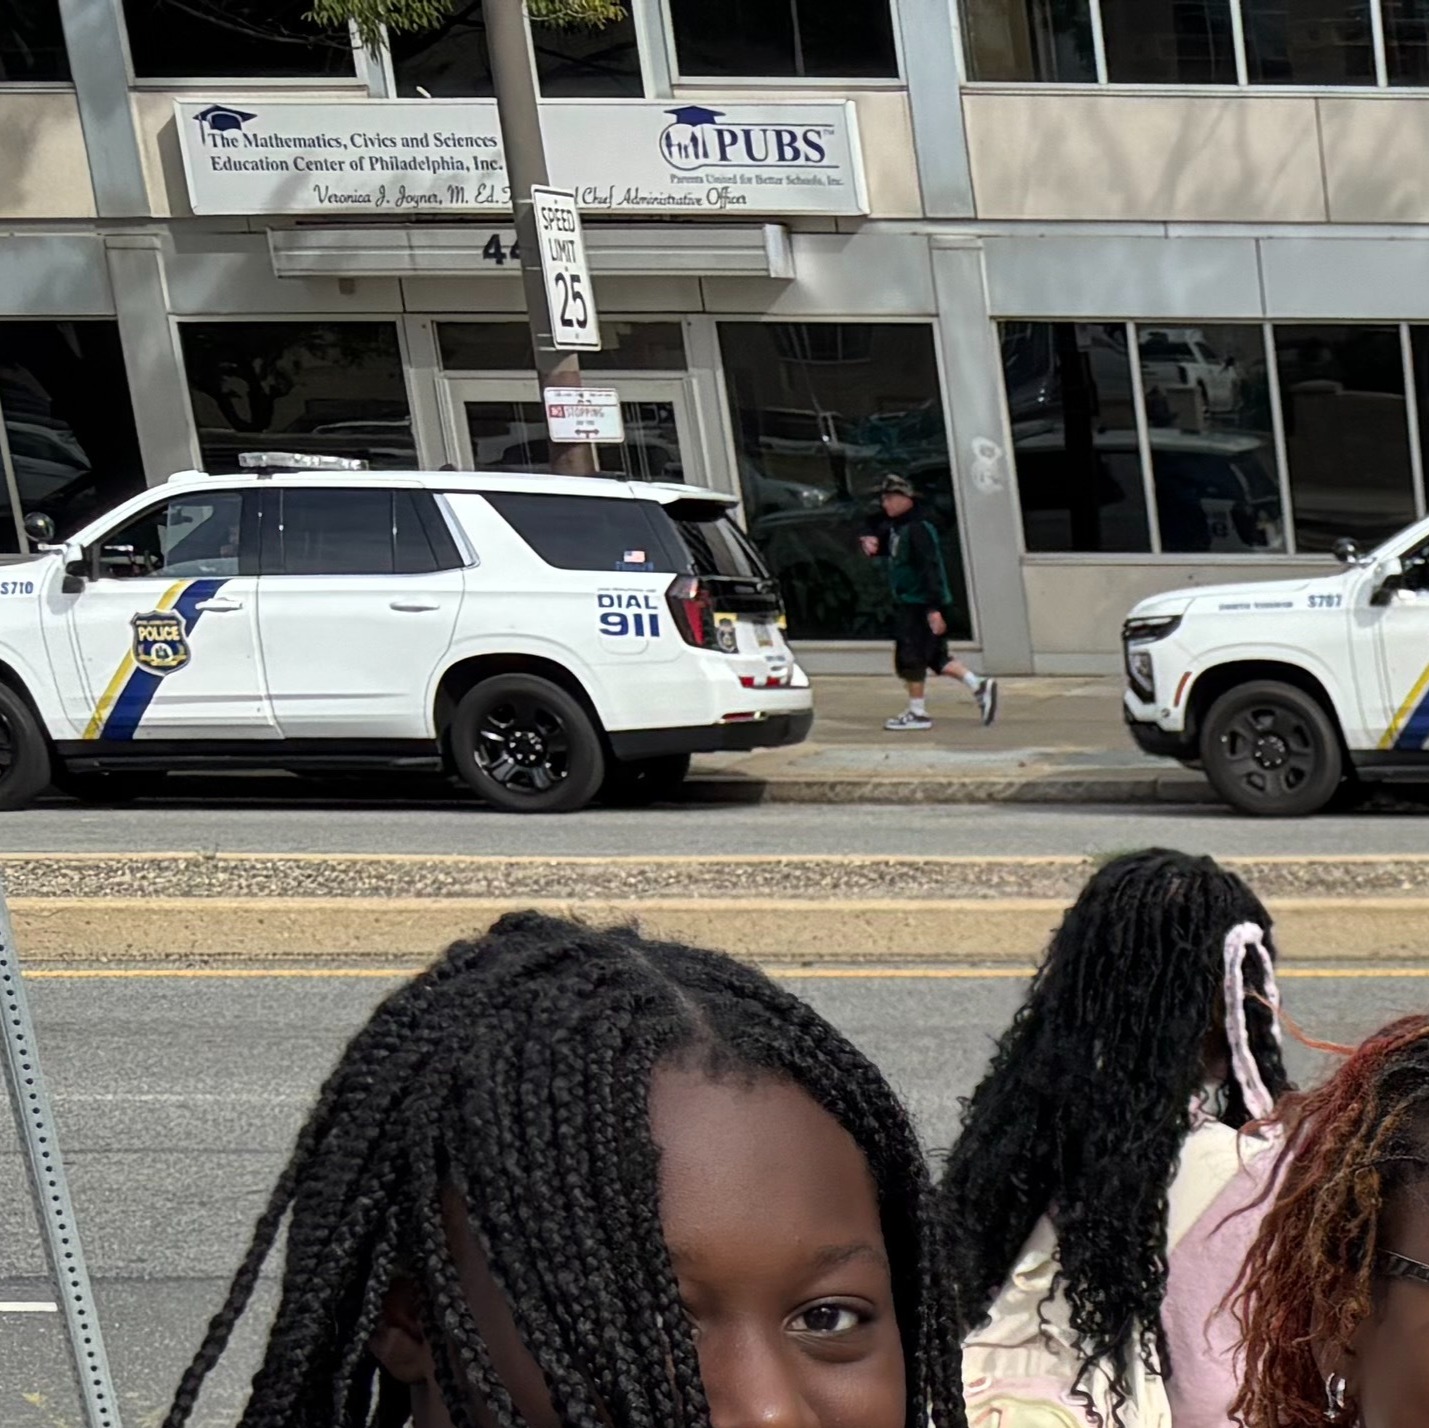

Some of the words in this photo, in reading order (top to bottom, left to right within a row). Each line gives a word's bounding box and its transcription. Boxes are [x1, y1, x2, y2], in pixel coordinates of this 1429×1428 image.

[208, 133, 239, 148] The
[243, 133, 348, 150] Mathematics,
[350, 133, 397, 148] Civics
[400, 133, 430, 147] and
[433, 132, 498, 148] Sciences
[716, 129, 825, 163] PUBS
[210, 156, 289, 171] Education
[293, 156, 345, 171] Center
[350, 156, 366, 171] of
[369, 156, 470, 174] Philadelphia,
[472, 156, 503, 171] Inc.
[313, 184, 372, 204] Veronica
[541, 206, 575, 233] SPEED
[548, 238, 576, 263] LIMIT
[555, 272, 588, 329] 25
[597, 594, 658, 609] DIAL
[138, 626, 180, 641] POLICE
[599, 612, 660, 637] 911
